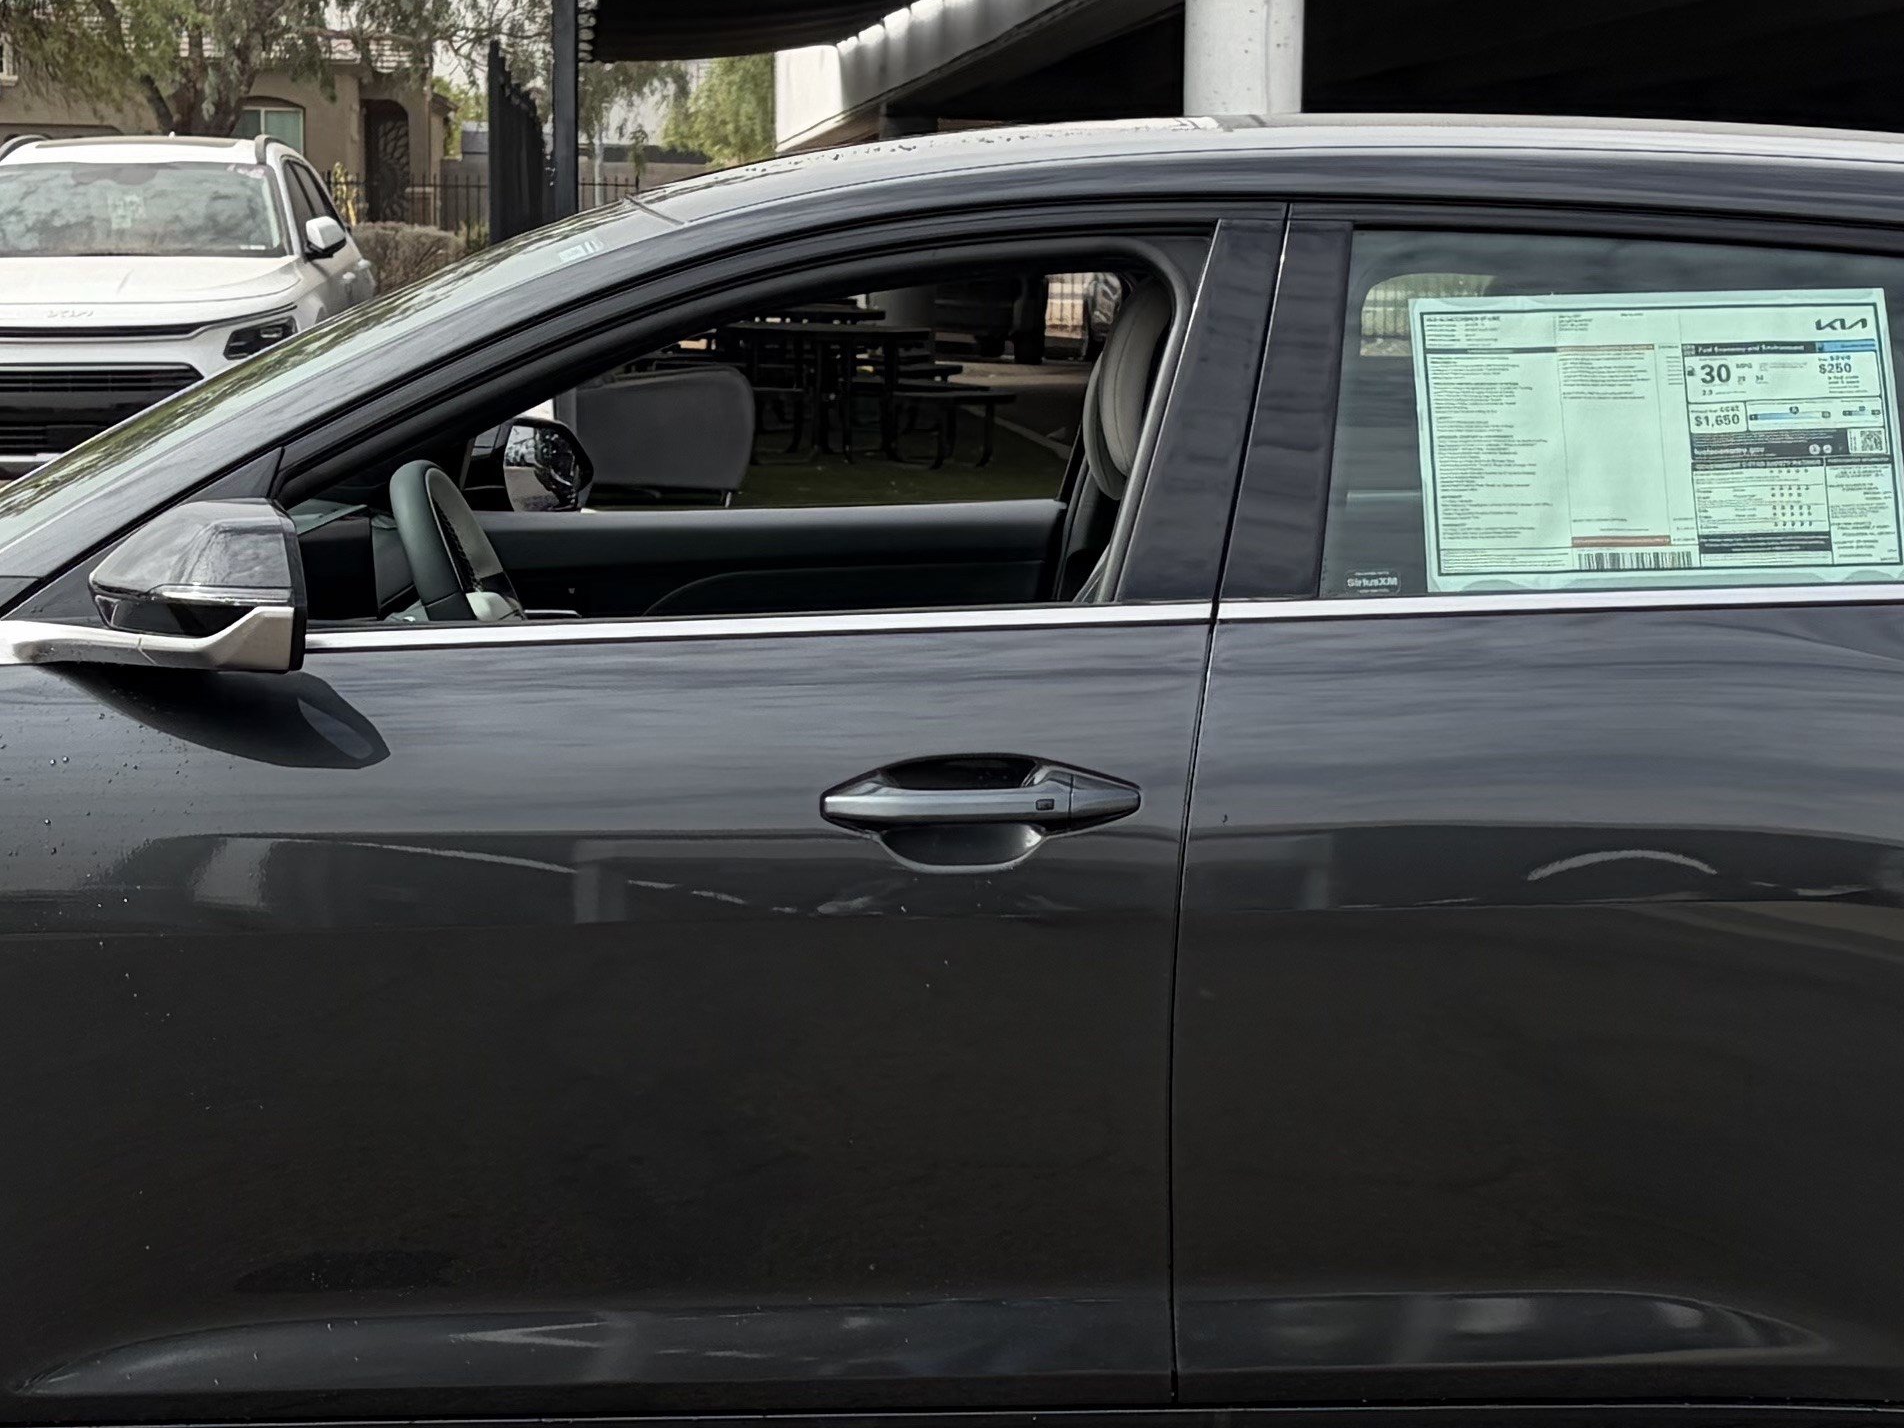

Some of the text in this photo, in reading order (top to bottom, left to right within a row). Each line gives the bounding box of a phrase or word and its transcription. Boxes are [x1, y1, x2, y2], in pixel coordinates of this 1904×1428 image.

[1815, 317, 1868, 331] KIA
[1700, 363, 1732, 384] 30
[1818, 362, 1852, 374] $250
[1694, 414, 1740, 428] $1,650
[1347, 577, 1398, 587] SiriusXM
